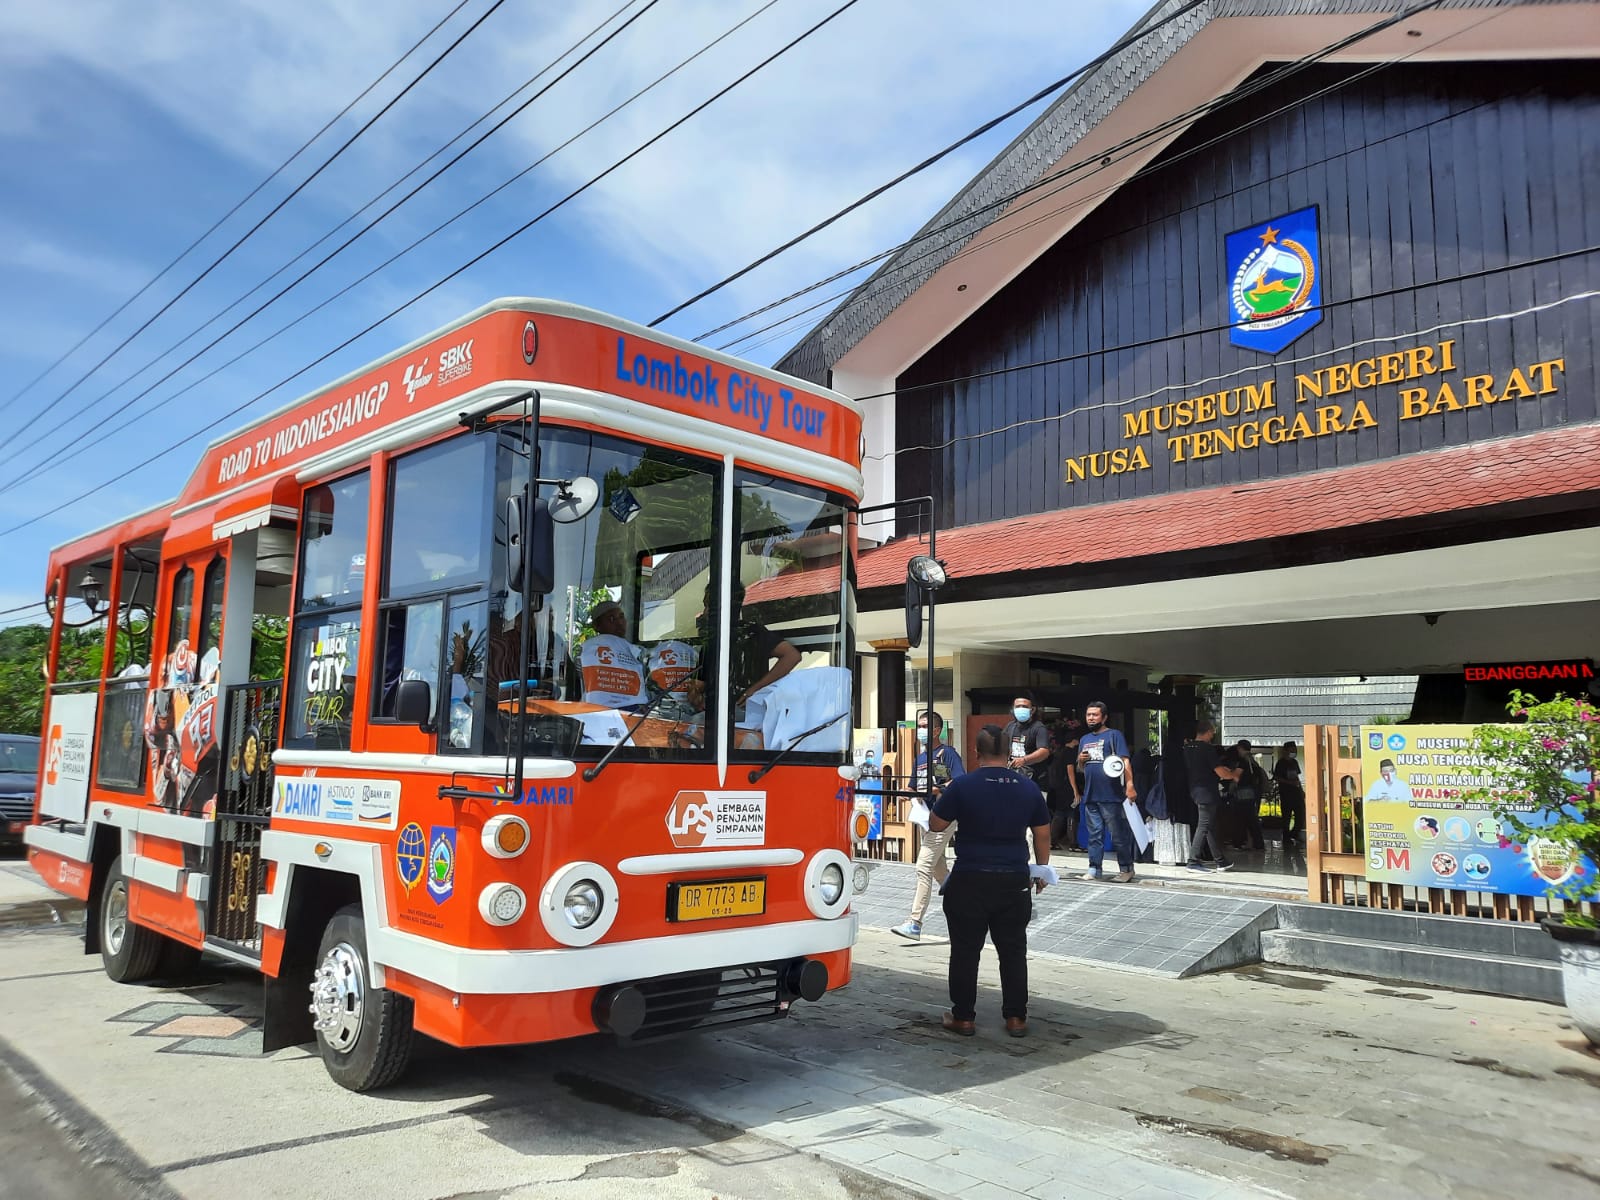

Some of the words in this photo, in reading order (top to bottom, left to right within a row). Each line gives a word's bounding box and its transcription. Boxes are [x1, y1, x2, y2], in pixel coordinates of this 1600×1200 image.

[438, 361, 473, 382] SUPERBIKE
[616, 337, 719, 407] Lombok
[728, 373, 773, 432] City
[780, 389, 826, 438] Tour
[1123, 380, 1276, 439] MUSEUM
[1295, 340, 1457, 403] NEGERI
[218, 447, 252, 483] ROAD
[254, 437, 272, 469] TO
[272, 381, 390, 461] INDONESIANGP
[1065, 445, 1152, 484] NUSA
[1168, 400, 1378, 463] TENGGARA
[1399, 359, 1565, 421] BARAT
[307, 656, 346, 693] CITY
[1465, 664, 1577, 681] EBANGGAAN
[304, 695, 344, 726] TOUR
[1397, 754, 1429, 765] NUSA
[1409, 774, 1434, 785] ANDA
[1436, 775, 1485, 786] MEMASUKI
[285, 783, 321, 817] DAMRI
[1411, 788, 1460, 799] WAJB
[668, 804, 713, 835] LPS
[717, 804, 761, 813] LEMBAGA
[717, 814, 764, 823] PENJAMIN
[716, 824, 763, 834] SIMPANAN
[1369, 840, 1411, 848] KESEHATAN
[1370, 847, 1411, 871] 5M
[686, 888, 701, 907] DR
[706, 886, 736, 907] 7773
[741, 885, 756, 904] AB
